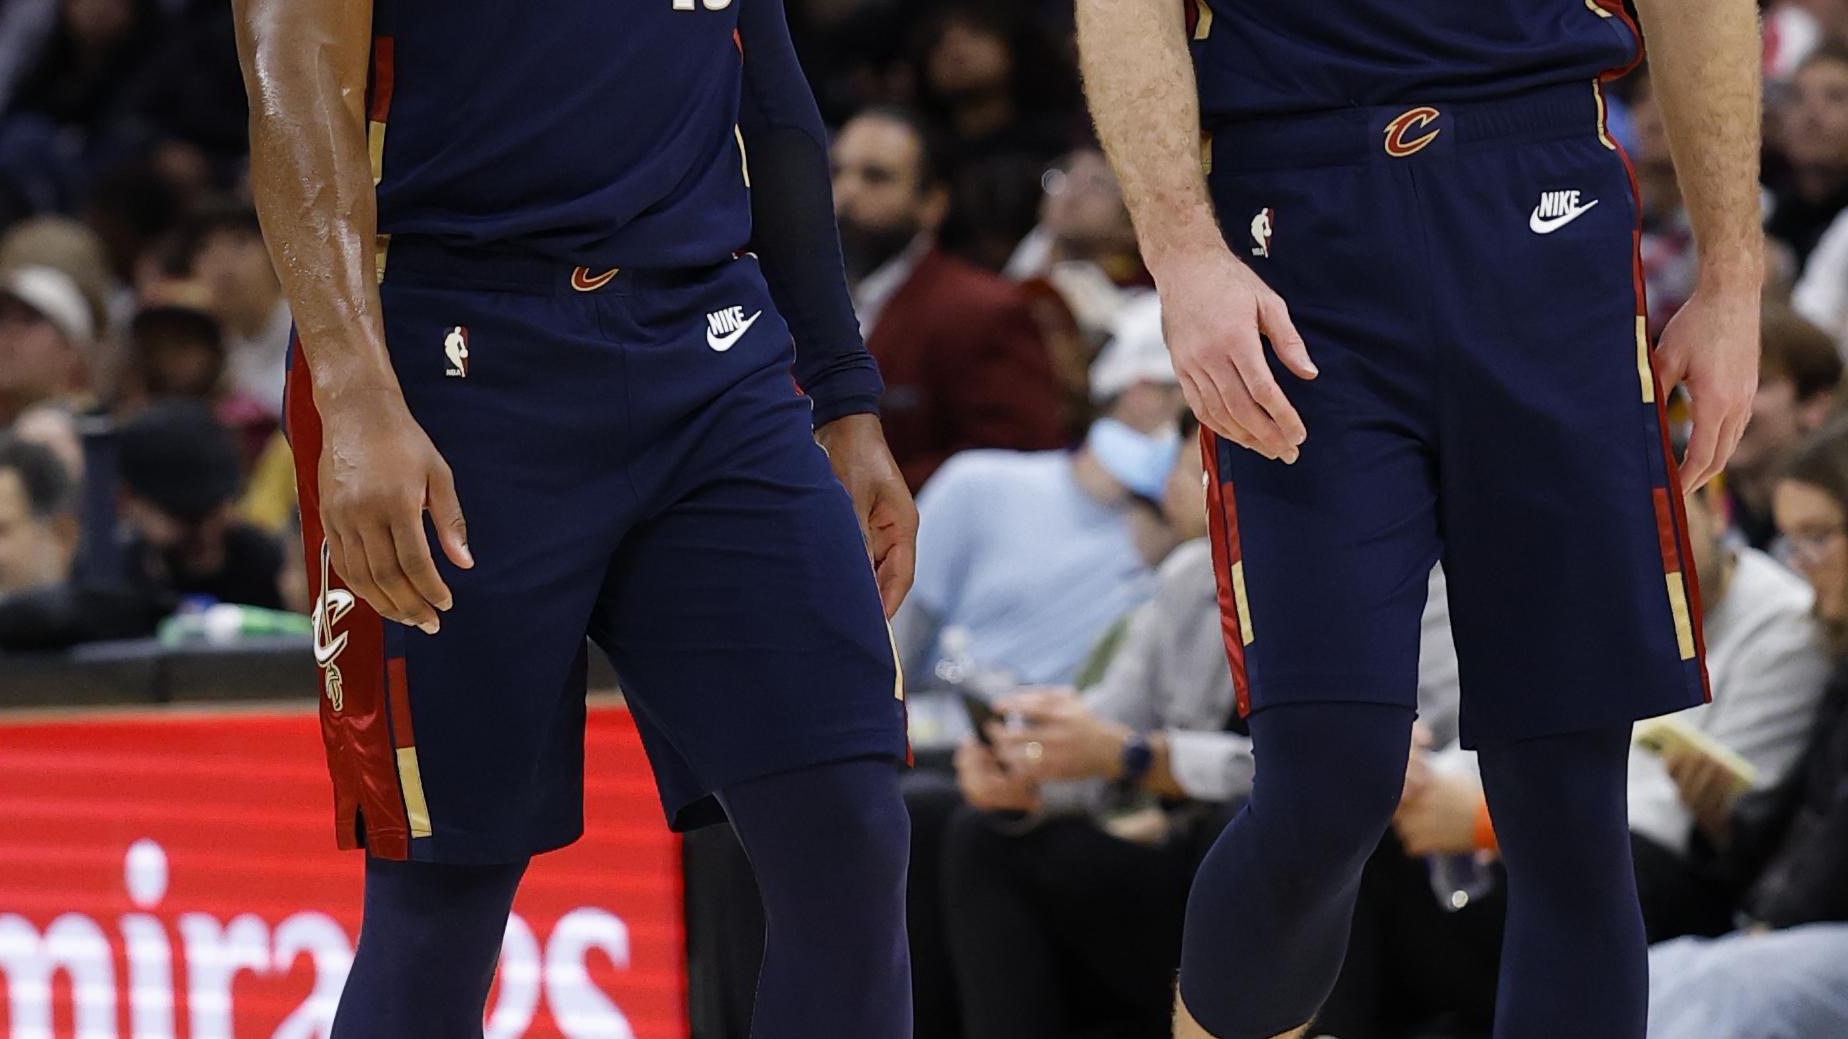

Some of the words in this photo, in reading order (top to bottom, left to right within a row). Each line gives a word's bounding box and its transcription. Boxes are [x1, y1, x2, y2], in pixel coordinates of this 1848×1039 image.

[1384, 107, 1440, 157] C
[1538, 190, 1580, 218] NIKE
[706, 305, 745, 336] NIKE
